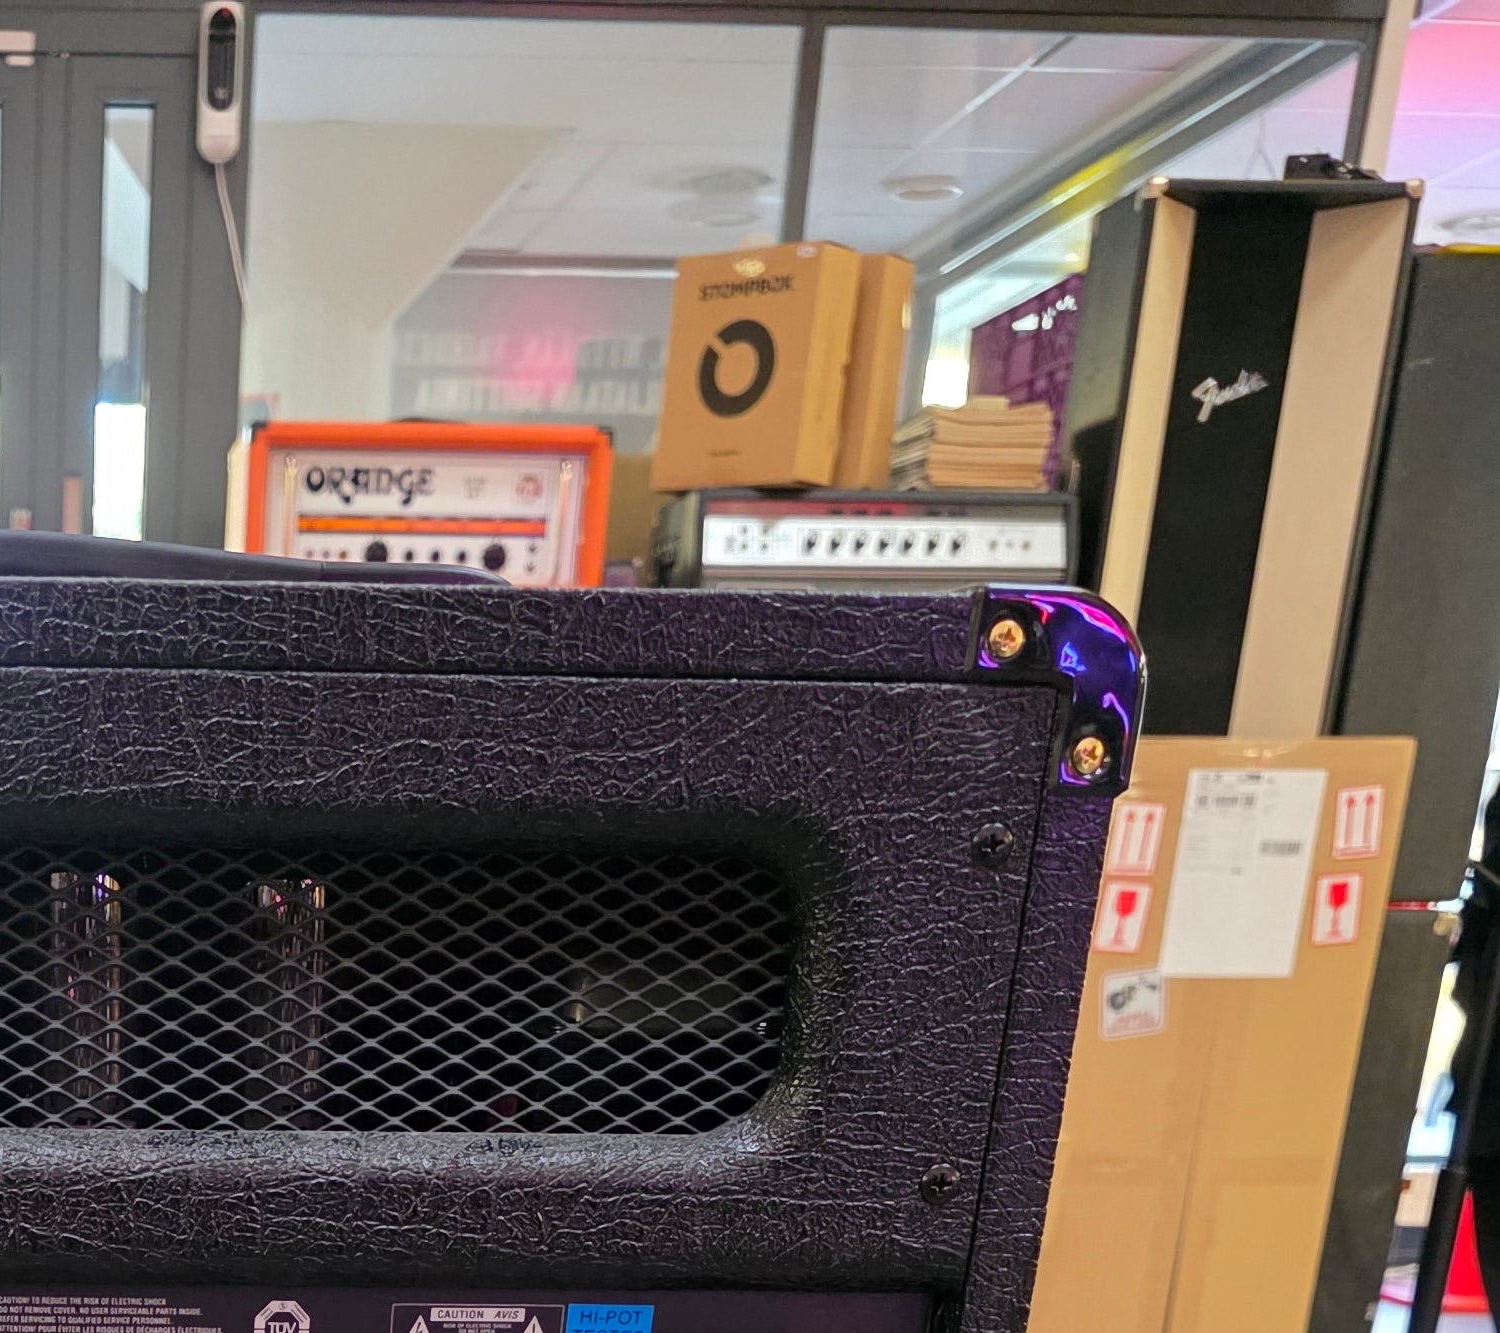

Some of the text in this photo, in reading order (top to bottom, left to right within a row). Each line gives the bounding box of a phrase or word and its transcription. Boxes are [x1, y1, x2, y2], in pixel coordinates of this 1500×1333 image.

[306, 466, 436, 505] ORANGE
[32, 1296, 40, 1305] TO
[437, 1310, 484, 1319] CAUTION
[493, 1310, 520, 1320] AVIS
[579, 1310, 644, 1325] HI-POT
